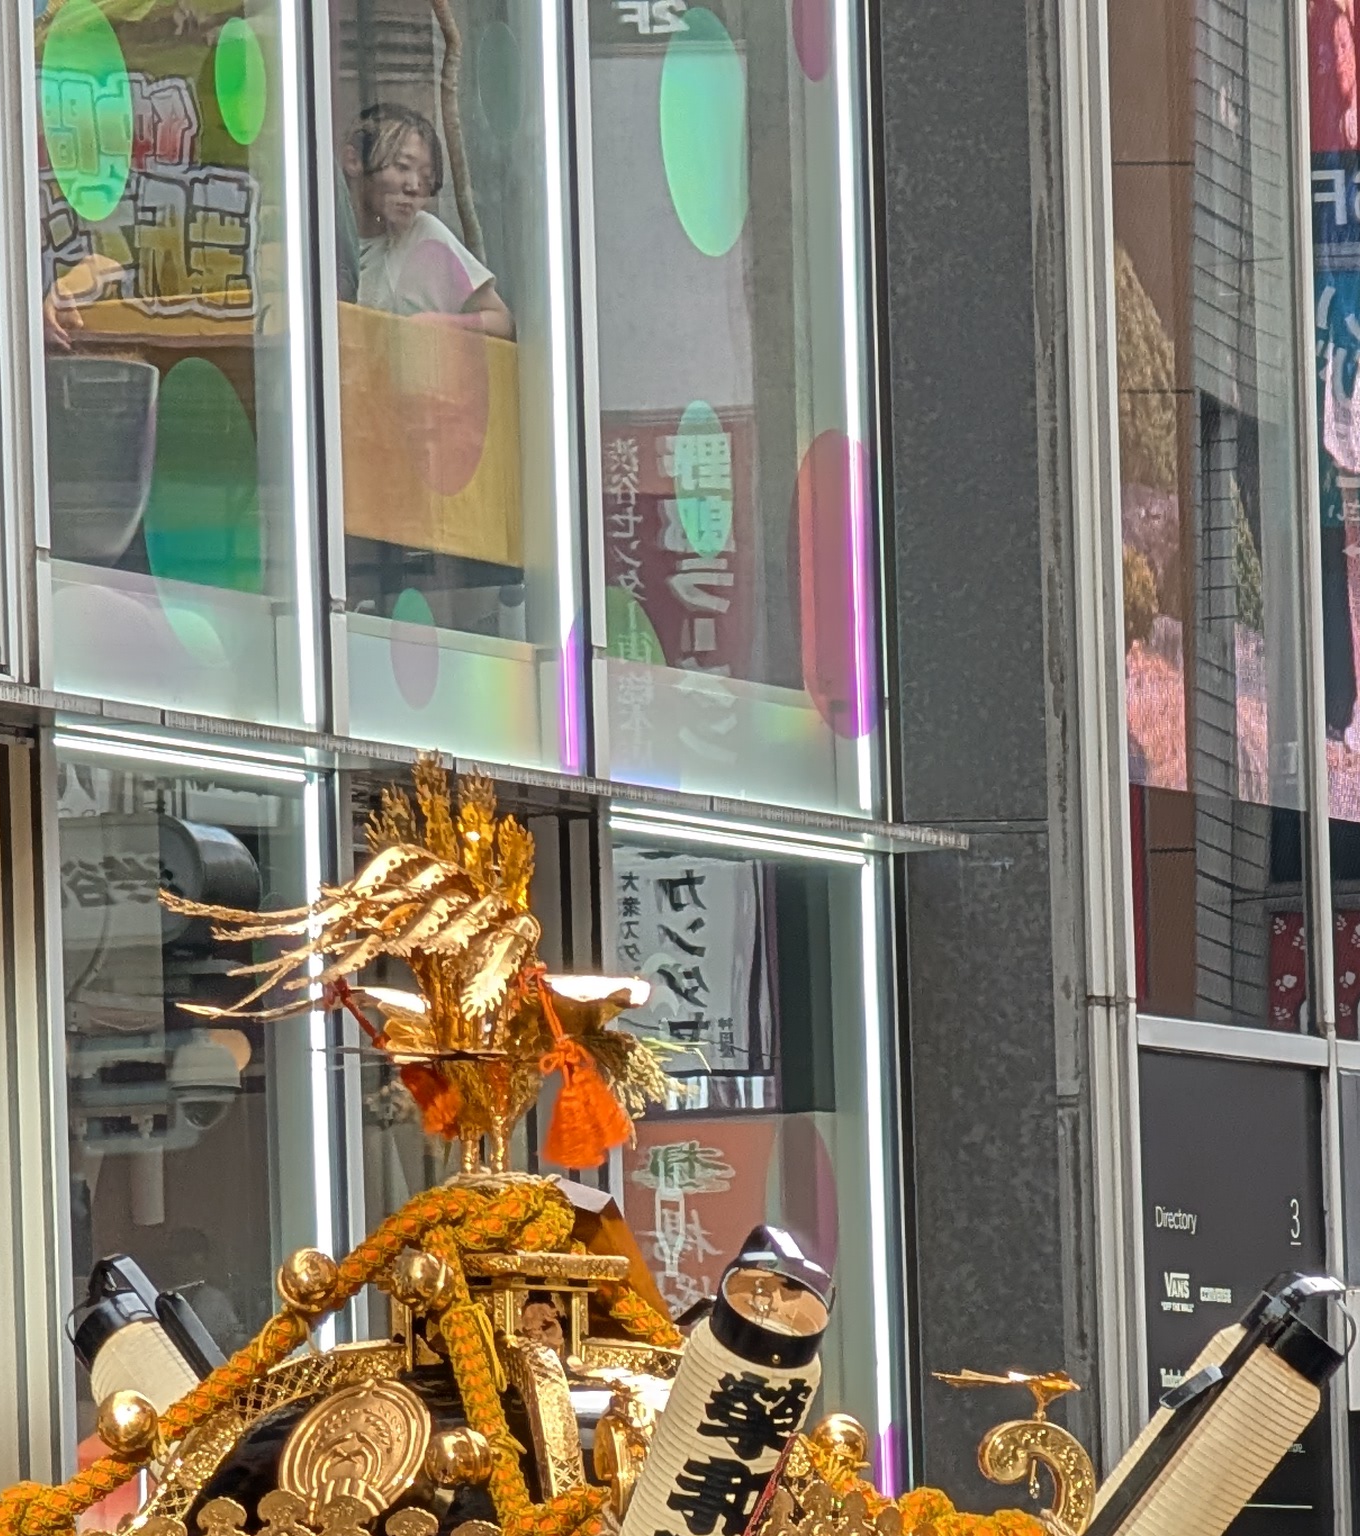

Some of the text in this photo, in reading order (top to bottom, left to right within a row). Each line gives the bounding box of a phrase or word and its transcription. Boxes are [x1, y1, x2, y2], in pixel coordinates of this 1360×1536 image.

[1154, 1198, 1302, 1239] Directory 3
[1163, 1271, 1191, 1300] VANS
